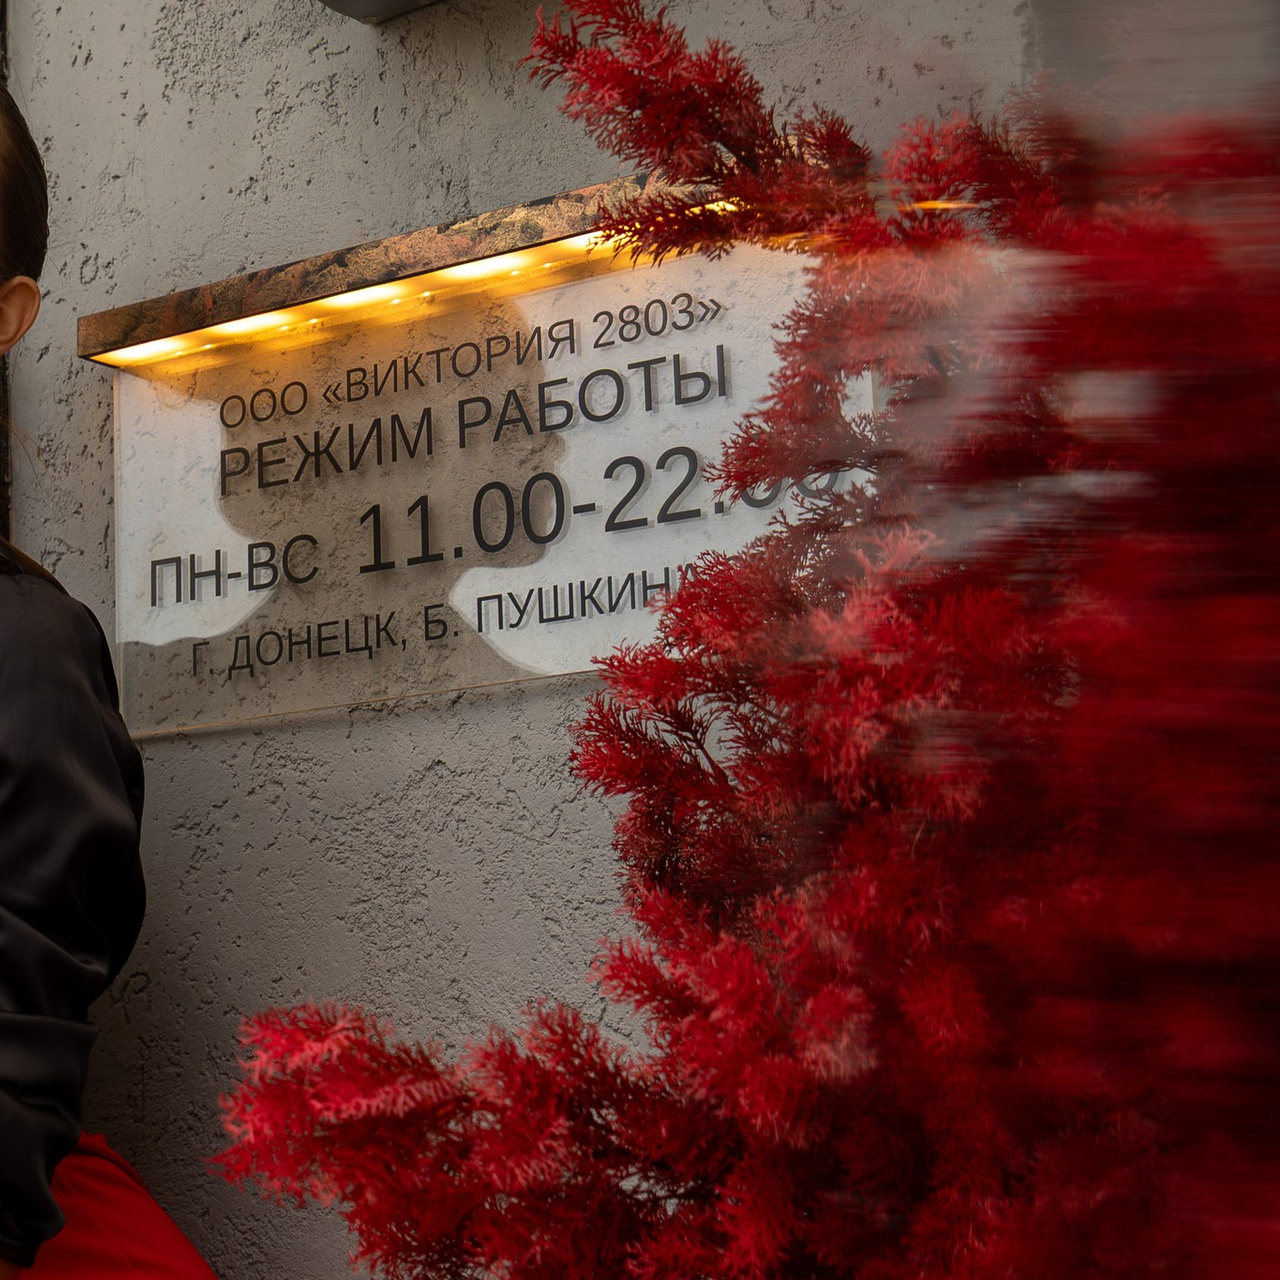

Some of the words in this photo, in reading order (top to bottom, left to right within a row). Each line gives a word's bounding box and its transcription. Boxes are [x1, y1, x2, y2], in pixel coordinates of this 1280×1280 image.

[219, 380, 308, 429] ООО
[322, 318, 576, 404] «ВИКТОРИЯ
[592, 292, 722, 349] 2803»
[220, 406, 434, 497] РЕЖИМ
[458, 344, 727, 450] РАБОТЫ
[150, 533, 320, 608] ПН-ВС
[227, 610, 407, 682] ДОНЕЦК,
[423, 602, 460, 642] Б.
